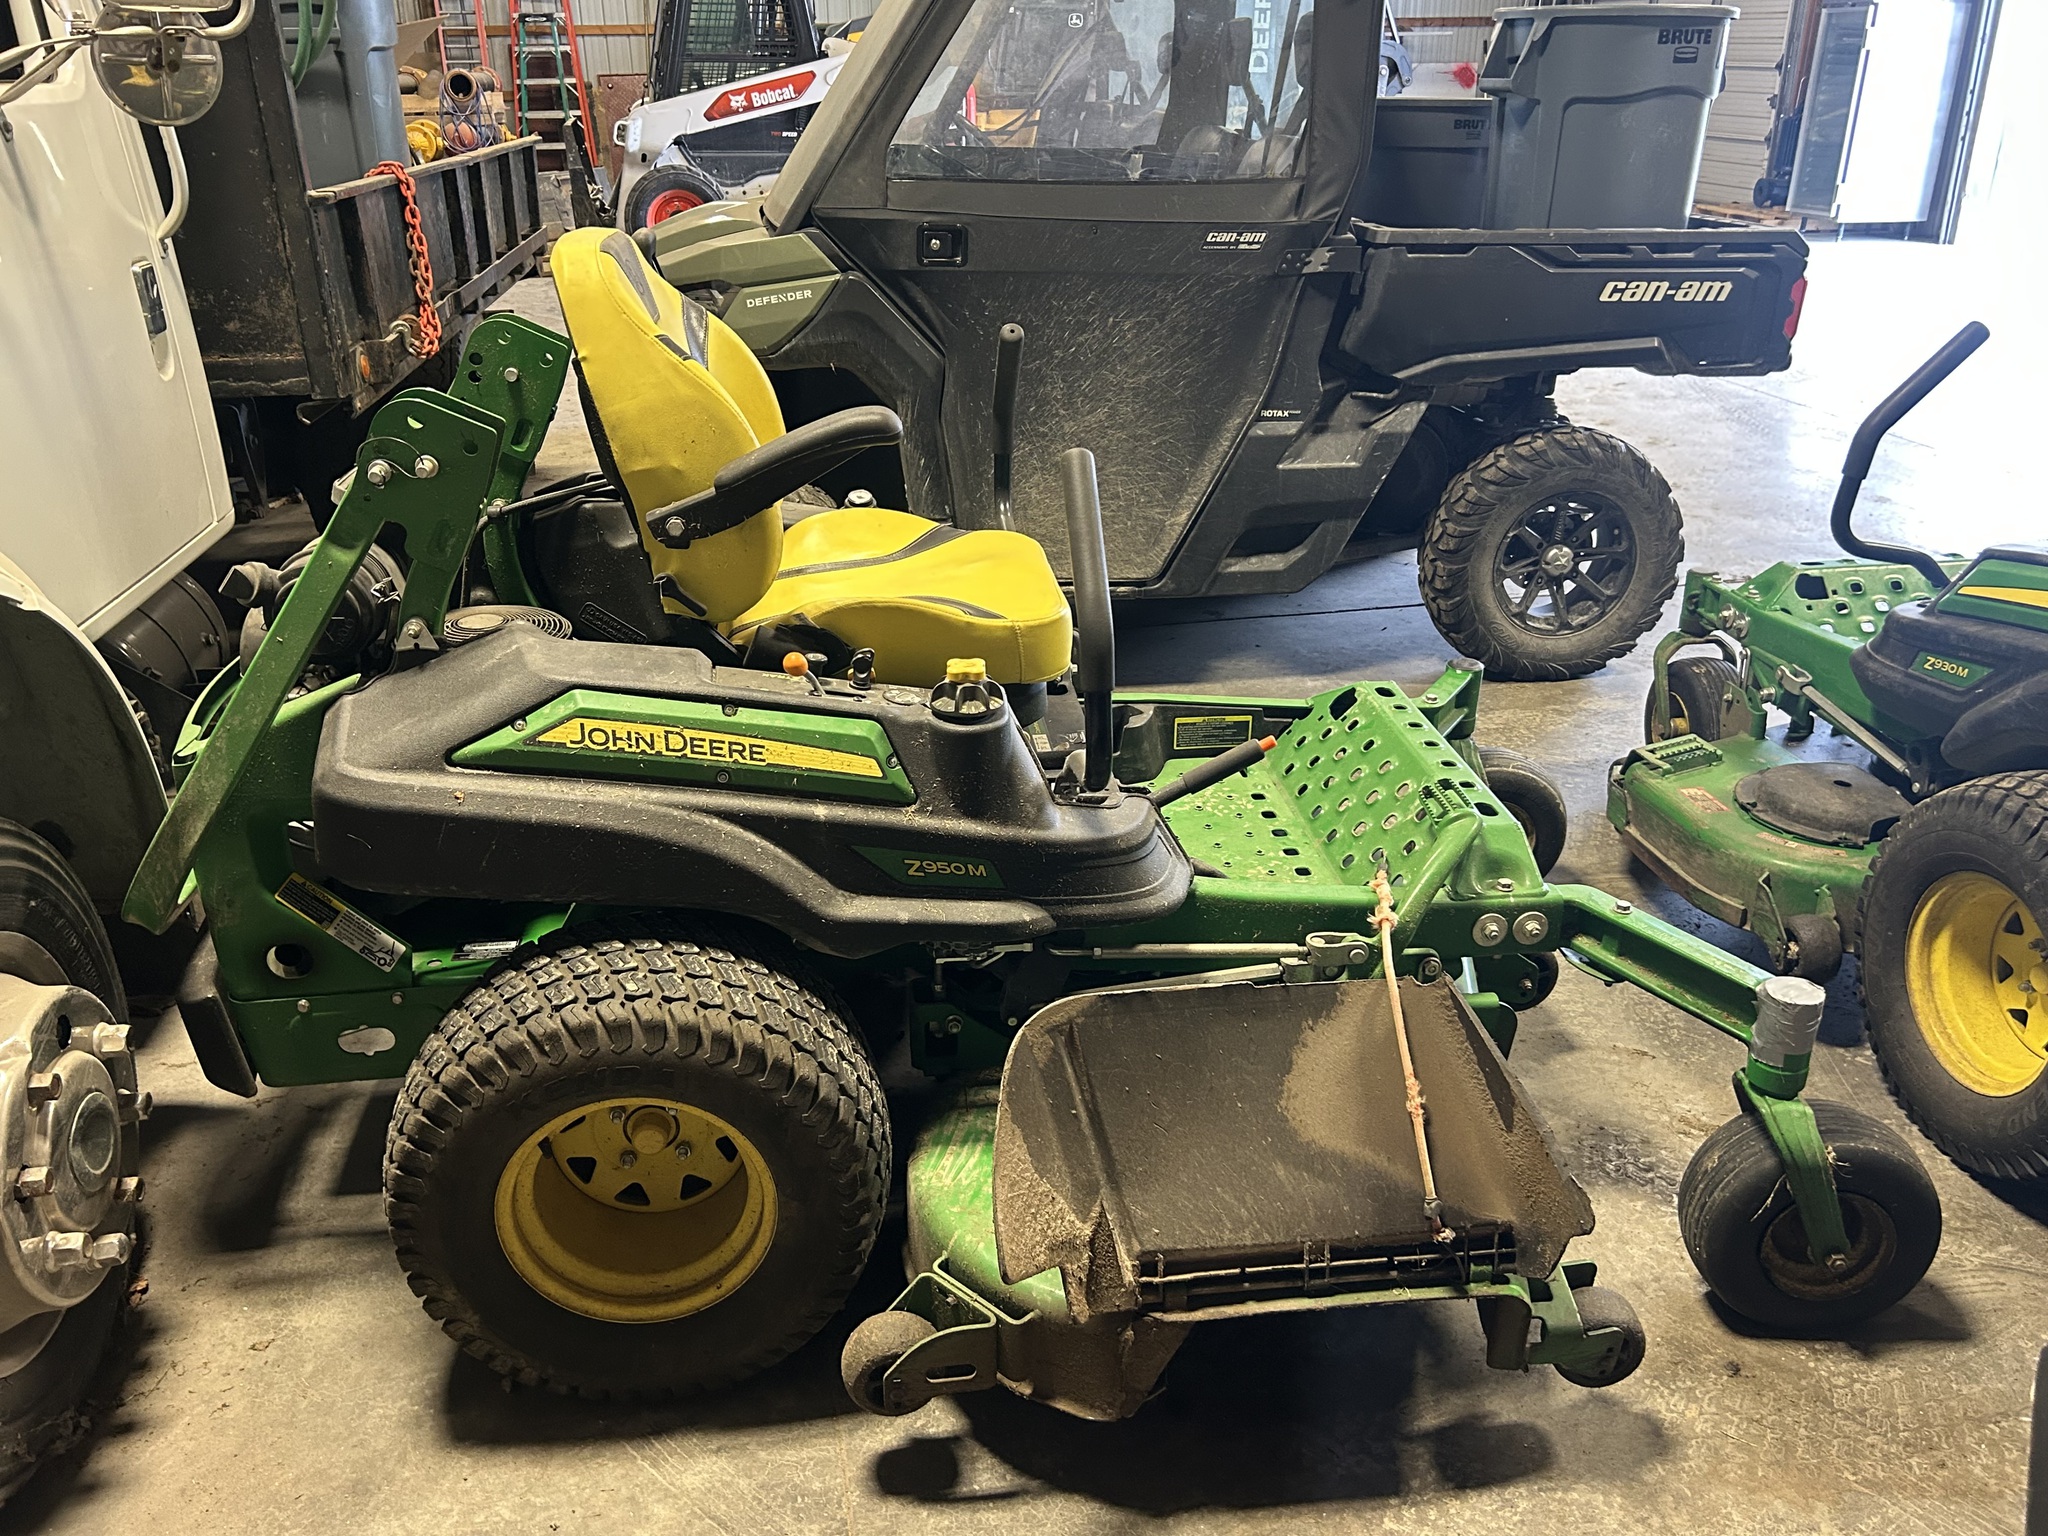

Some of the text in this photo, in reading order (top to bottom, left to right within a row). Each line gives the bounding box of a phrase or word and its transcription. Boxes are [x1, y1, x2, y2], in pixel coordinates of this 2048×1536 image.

[1657, 28, 1713, 45] BRUTE
[750, 83, 796, 108] Bobcat
[1453, 119, 1487, 130] BRUT
[1206, 232, 1267, 242] can-am
[746, 289, 812, 307] DEFENDER
[1599, 281, 1733, 302] can-am
[1923, 656, 1969, 678] Z930M
[569, 722, 766, 762] JOHN DEERE
[903, 859, 987, 877] Z950M
